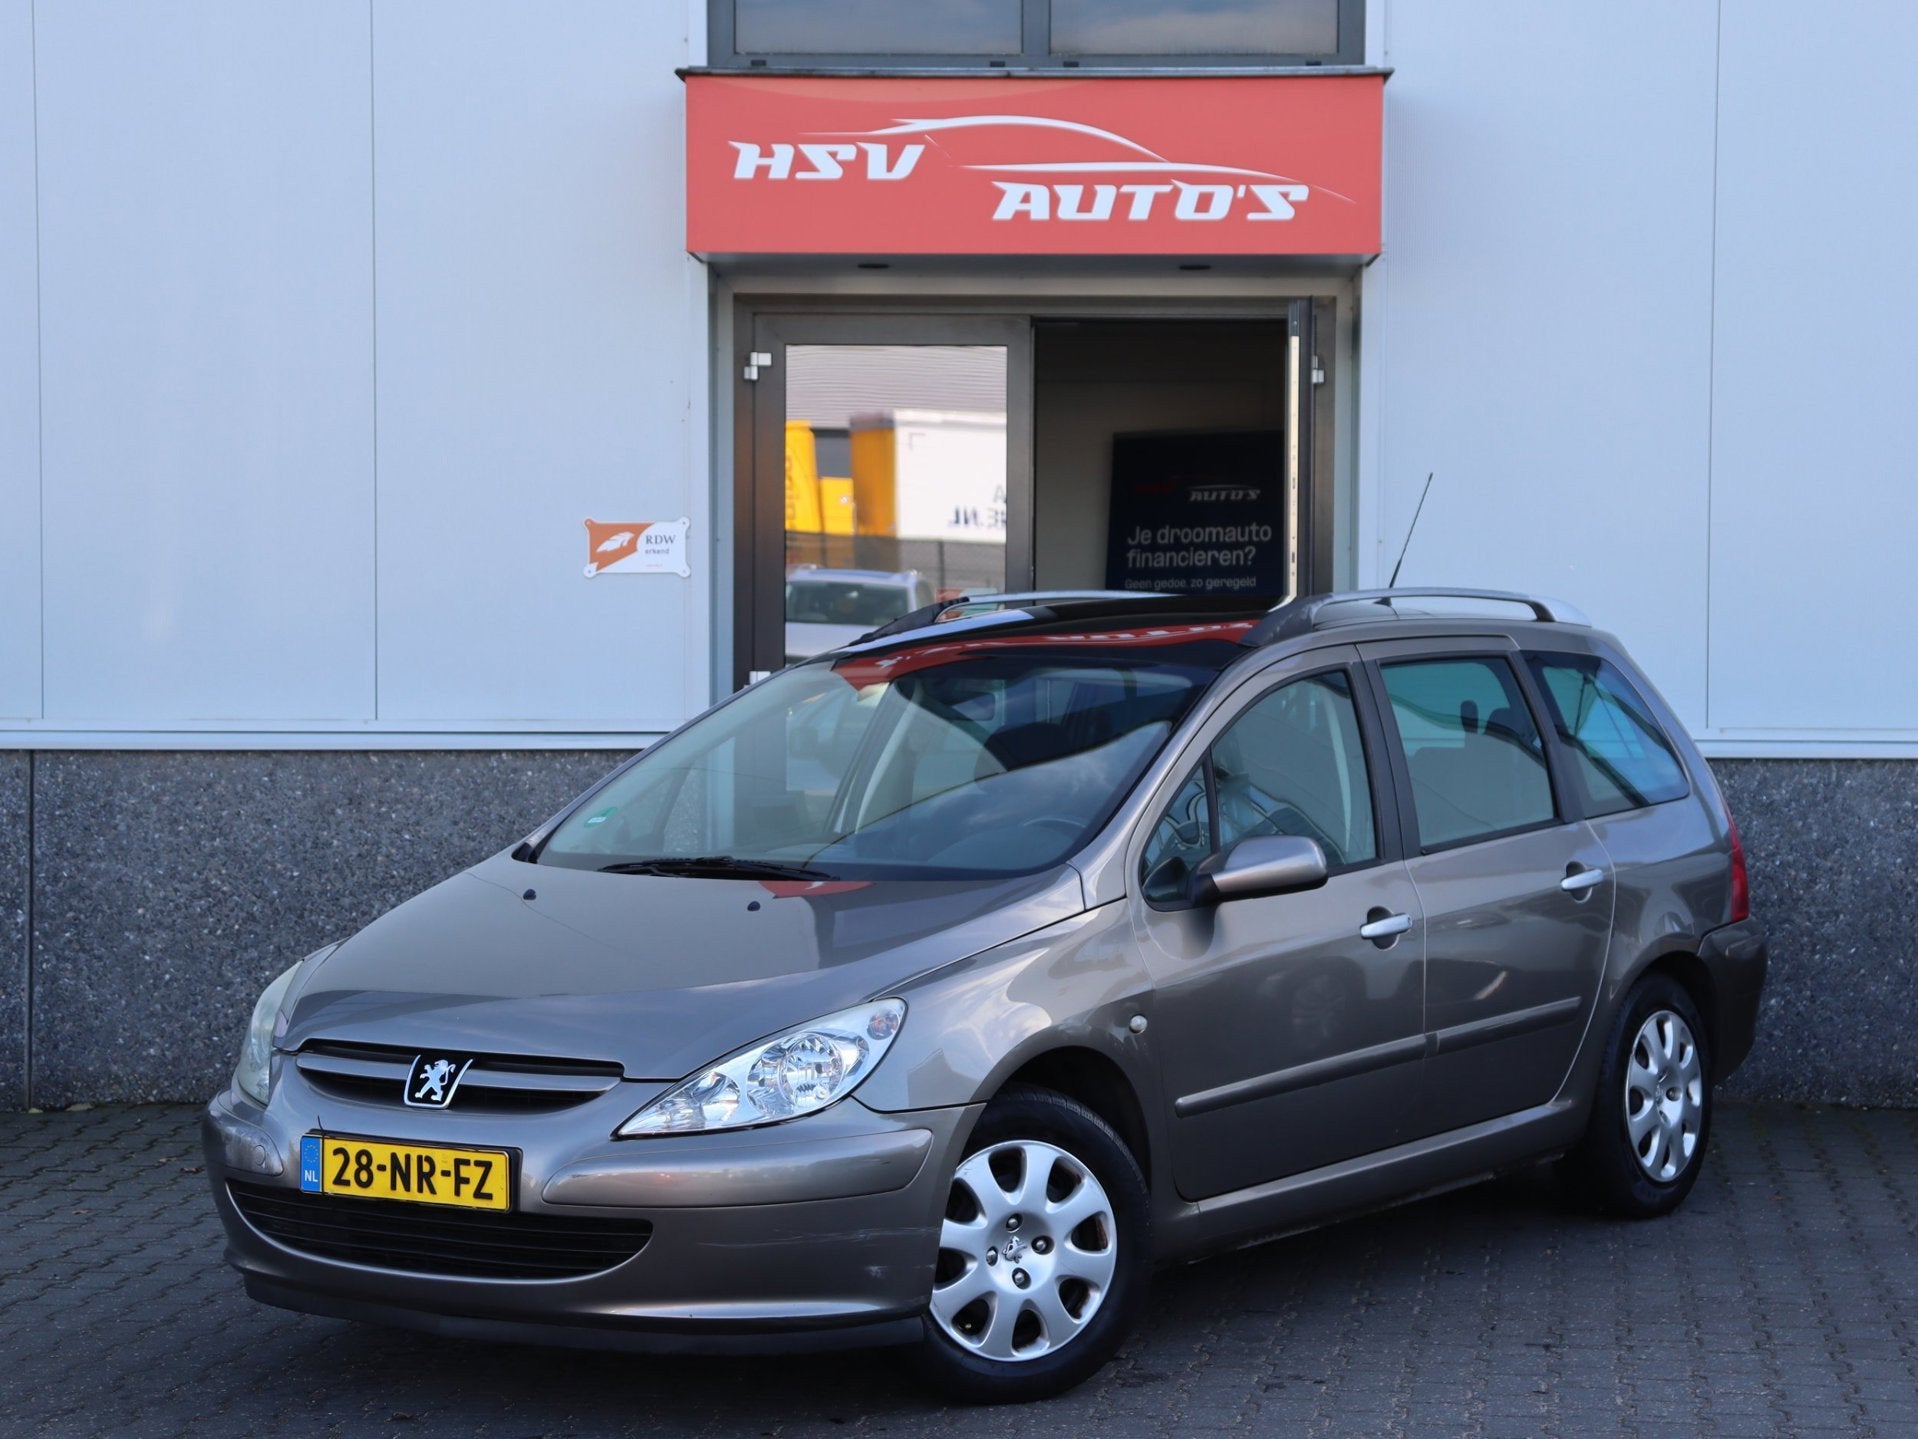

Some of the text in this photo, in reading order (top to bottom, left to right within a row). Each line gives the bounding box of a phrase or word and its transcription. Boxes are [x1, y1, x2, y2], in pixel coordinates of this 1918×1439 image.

[728, 140, 926, 180] HSV
[991, 178, 1309, 221] AUTO'S
[645, 534, 676, 545] RDW
[1127, 522, 1272, 545] Je droomauto
[1126, 546, 1256, 568] financieren?
[1124, 578, 1152, 589] Geen
[1190, 578, 1203, 588] zo
[1205, 576, 1257, 591] geregeld
[304, 1169, 318, 1182] NL
[332, 1147, 494, 1200] 28-NR-FZ
